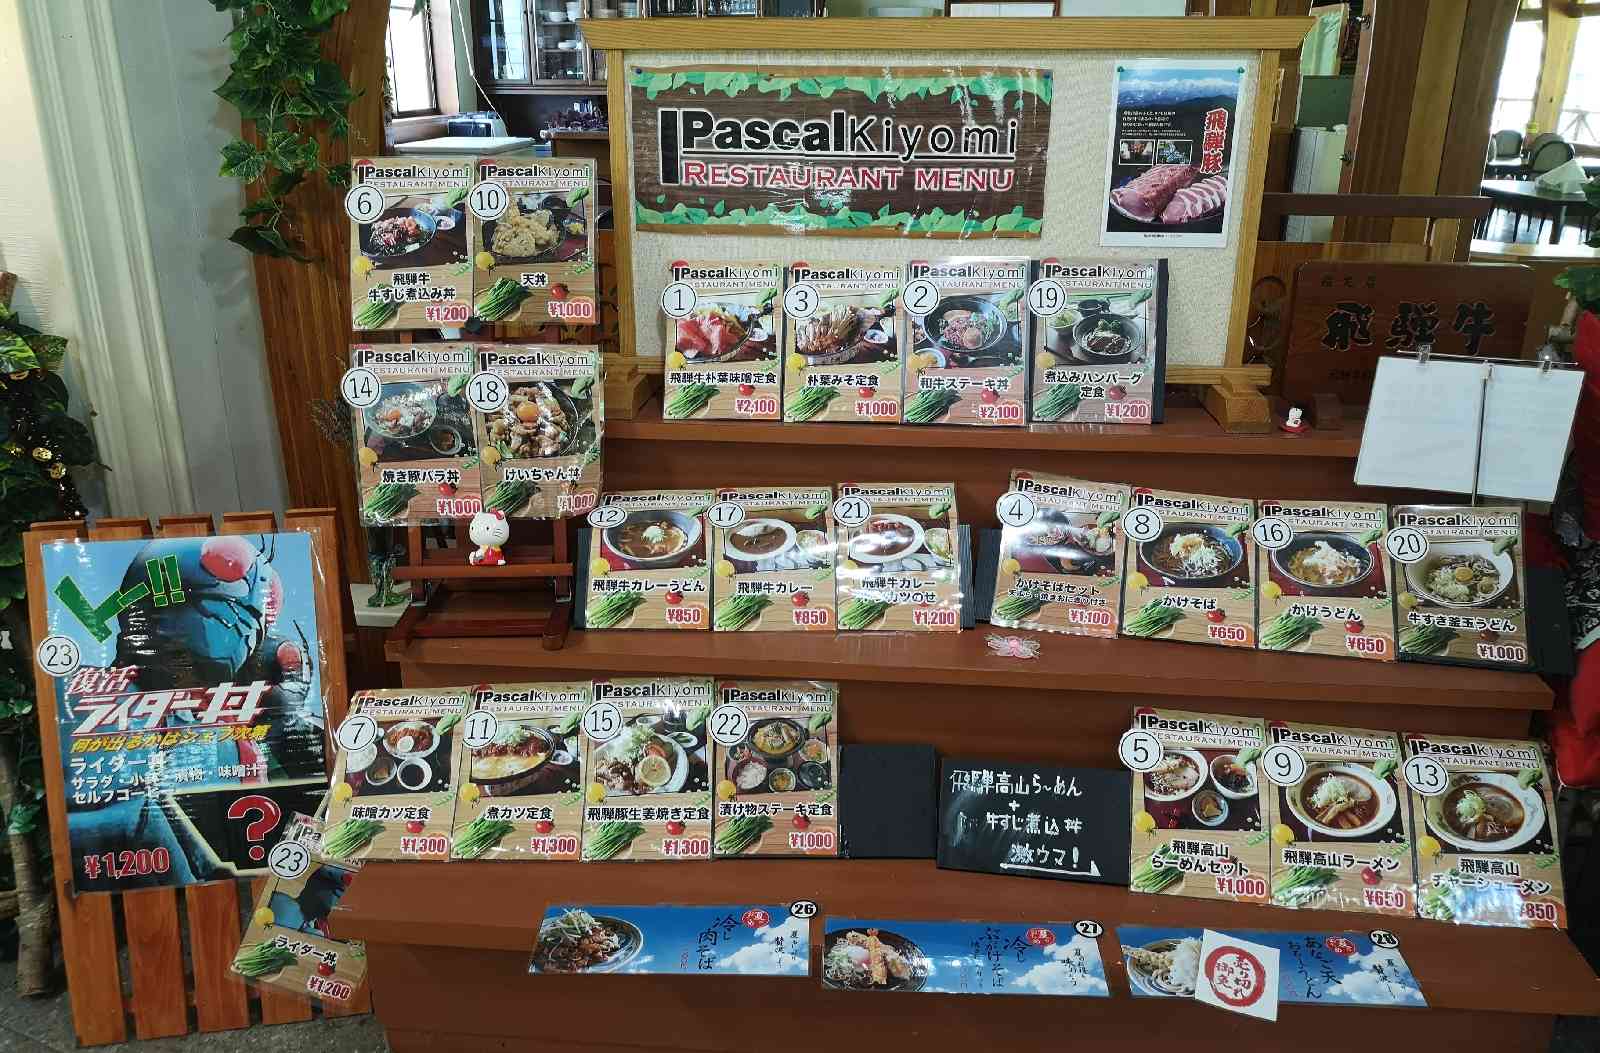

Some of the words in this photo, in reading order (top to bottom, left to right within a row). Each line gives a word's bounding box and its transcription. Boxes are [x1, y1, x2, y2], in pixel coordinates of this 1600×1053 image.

[683, 160, 902, 191] RESTAURANT
[915, 167, 1016, 192] MENU
[393, 273, 430, 285] 飛騨牛
[522, 273, 546, 286] 天丼
[368, 287, 456, 301] 牛すじ煮込み丼
[426, 306, 468, 321] ¥1,200
[549, 302, 591, 317] ¥1,000
[808, 374, 878, 387] 朴葉みそ定食
[920, 378, 1009, 391] 和牛ステーキ丼
[1045, 370, 1142, 384] 煮込みハンバーグ
[1080, 386, 1105, 399] 定食
[856, 401, 897, 415] ¥1,000
[979, 406, 1019, 419] ¥2,100
[1107, 403, 1147, 417] ¥1,200
[382, 469, 460, 484] 焼き豚バラ丼
[505, 468, 581, 481] けいちゃん丼
[437, 501, 481, 516] ¥1,000
[592, 579, 705, 592] 飛騨牛カレーうどん
[738, 582, 813, 594] 飛騨牛カレー
[1016, 578, 1100, 596] かけそばセット
[1162, 595, 1217, 610] かけそば
[666, 608, 701, 623] ¥850
[794, 609, 827, 624] ¥850
[914, 610, 955, 625] ¥1,200
[1070, 609, 1110, 625] ¥1,100
[1292, 604, 1361, 620] かけうどん
[1408, 613, 1516, 632] 牛すき釜玉うどん
[1209, 626, 1245, 641] ¥650
[1347, 637, 1384, 653] ¥650
[1479, 645, 1525, 661] ¥1,000
[71, 680, 272, 736] ライダー丼
[352, 807, 430, 820] 味噌カツ定食
[487, 807, 553, 820] 煮カツ定食
[587, 808, 710, 821] 飛騨豚生姜焼き定食
[720, 803, 832, 816] 漬け物ステーキ定食
[401, 838, 446, 853] ¥1,300
[532, 838, 576, 853] ¥1,300
[664, 839, 710, 854] ¥1,300
[791, 833, 832, 847] ¥1,000
[1172, 840, 1229, 858] 飛騨高山
[84, 847, 170, 880] ¥1,200
[1152, 856, 1249, 874] らーめんセット
[1284, 850, 1399, 871] 飛騨高山ラーメン
[1460, 858, 1520, 876] 飛騨高山
[1217, 878, 1265, 895] ¥1,000
[1365, 890, 1405, 906] ¥650
[273, 936, 338, 964] ライダー丼
[309, 976, 350, 1000] ¥1,200
